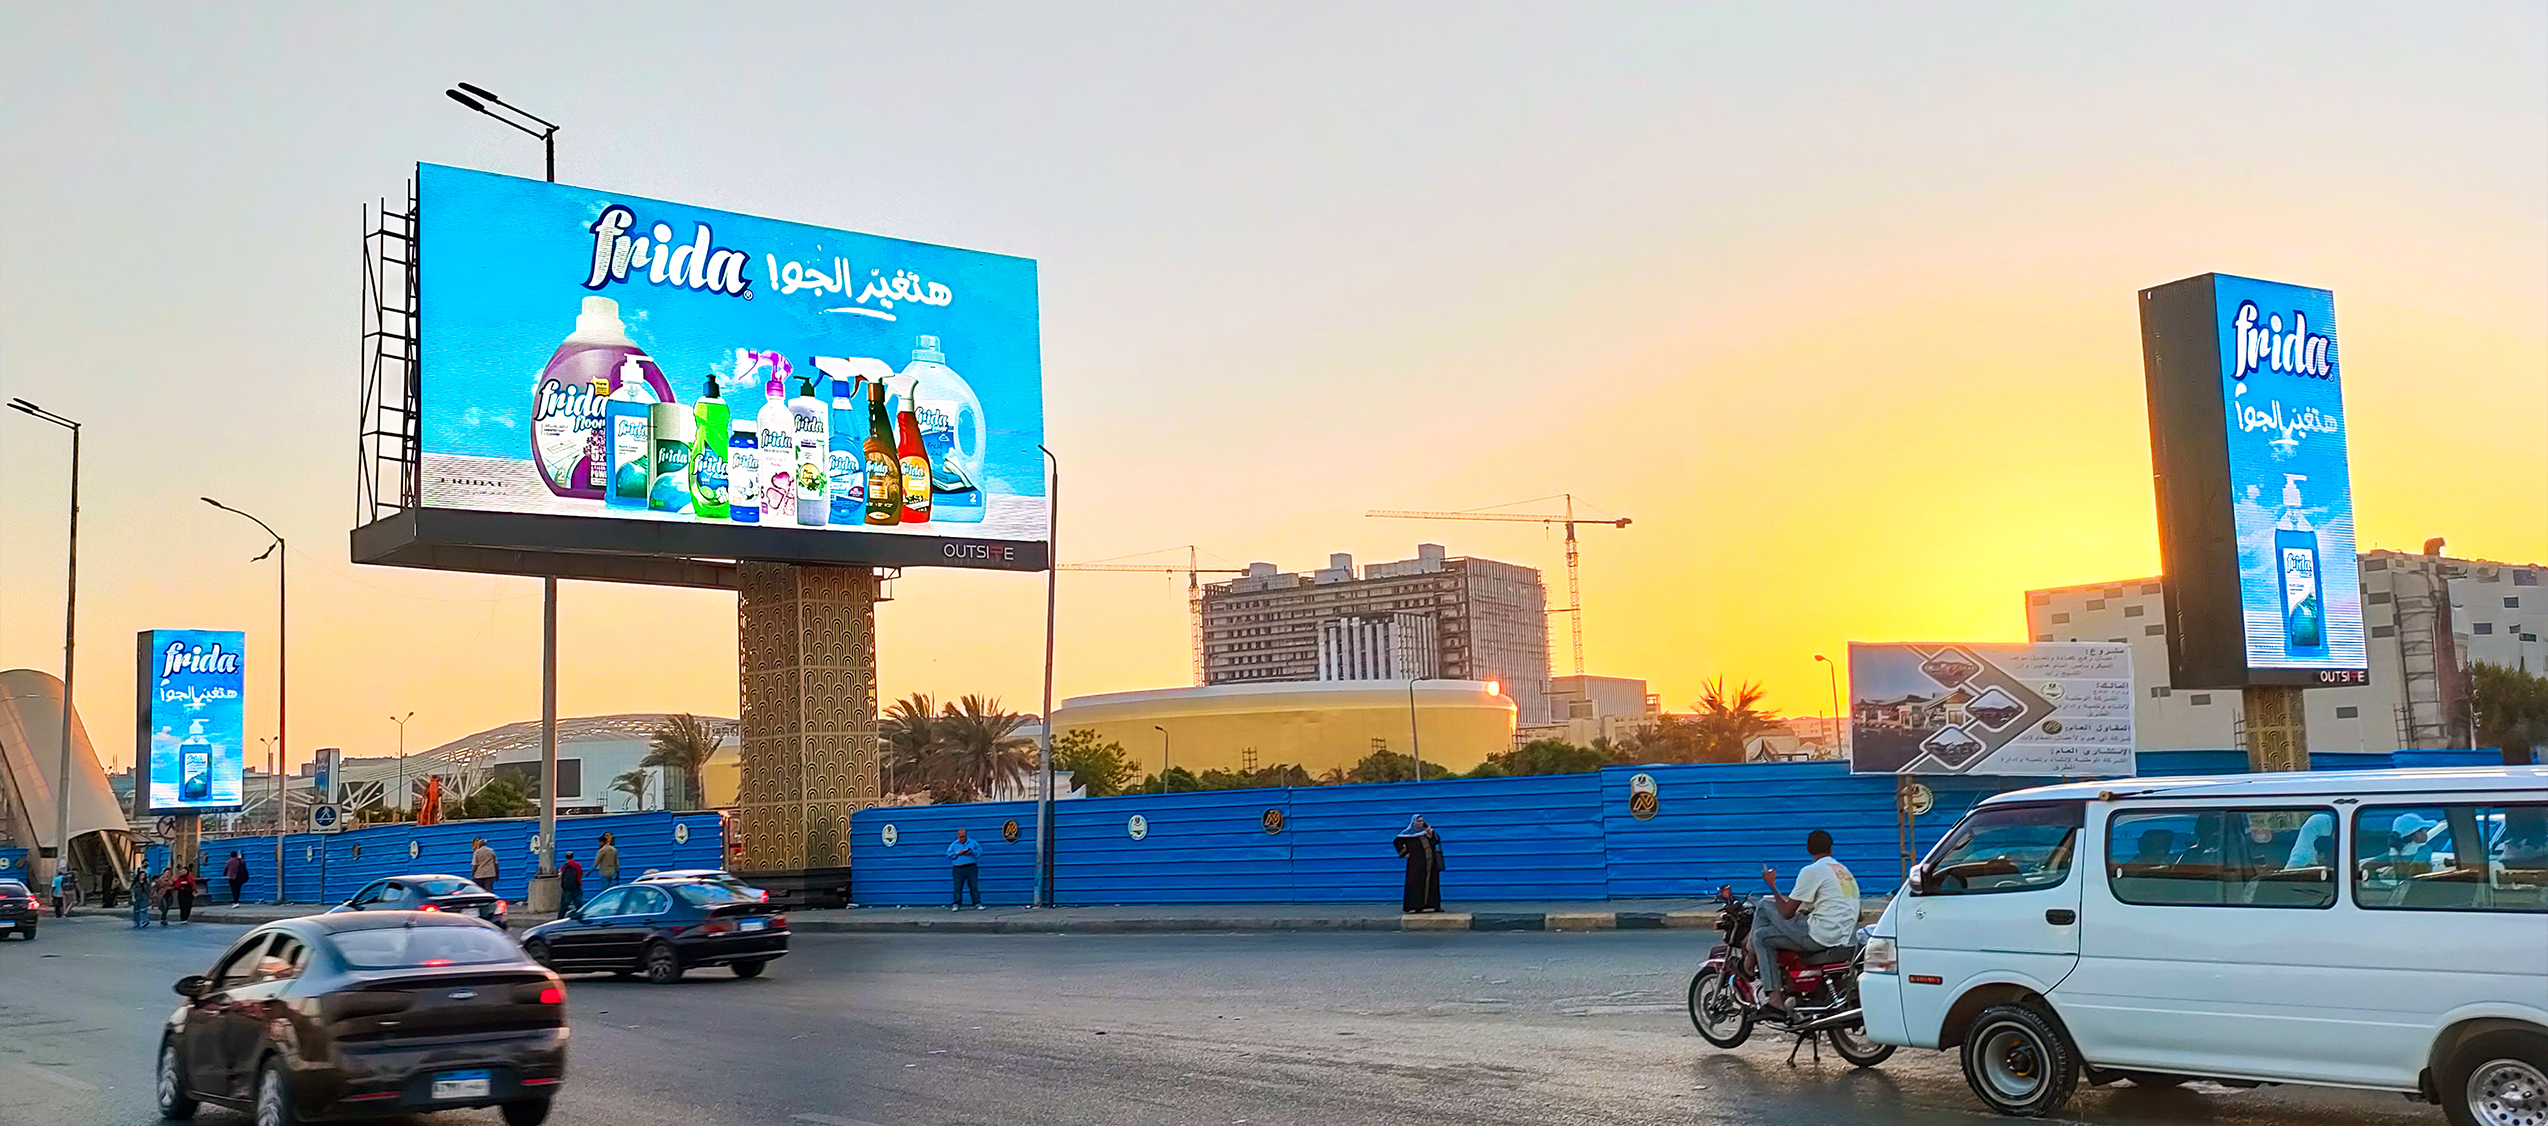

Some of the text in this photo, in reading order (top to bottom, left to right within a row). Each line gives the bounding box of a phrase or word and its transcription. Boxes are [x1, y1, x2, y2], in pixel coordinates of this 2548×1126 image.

[582, 204, 752, 297] frida
[2231, 300, 2333, 380] frida
[658, 448, 688, 464] frida
[969, 493, 977, 503] 2
[160, 641, 239, 678] frida
